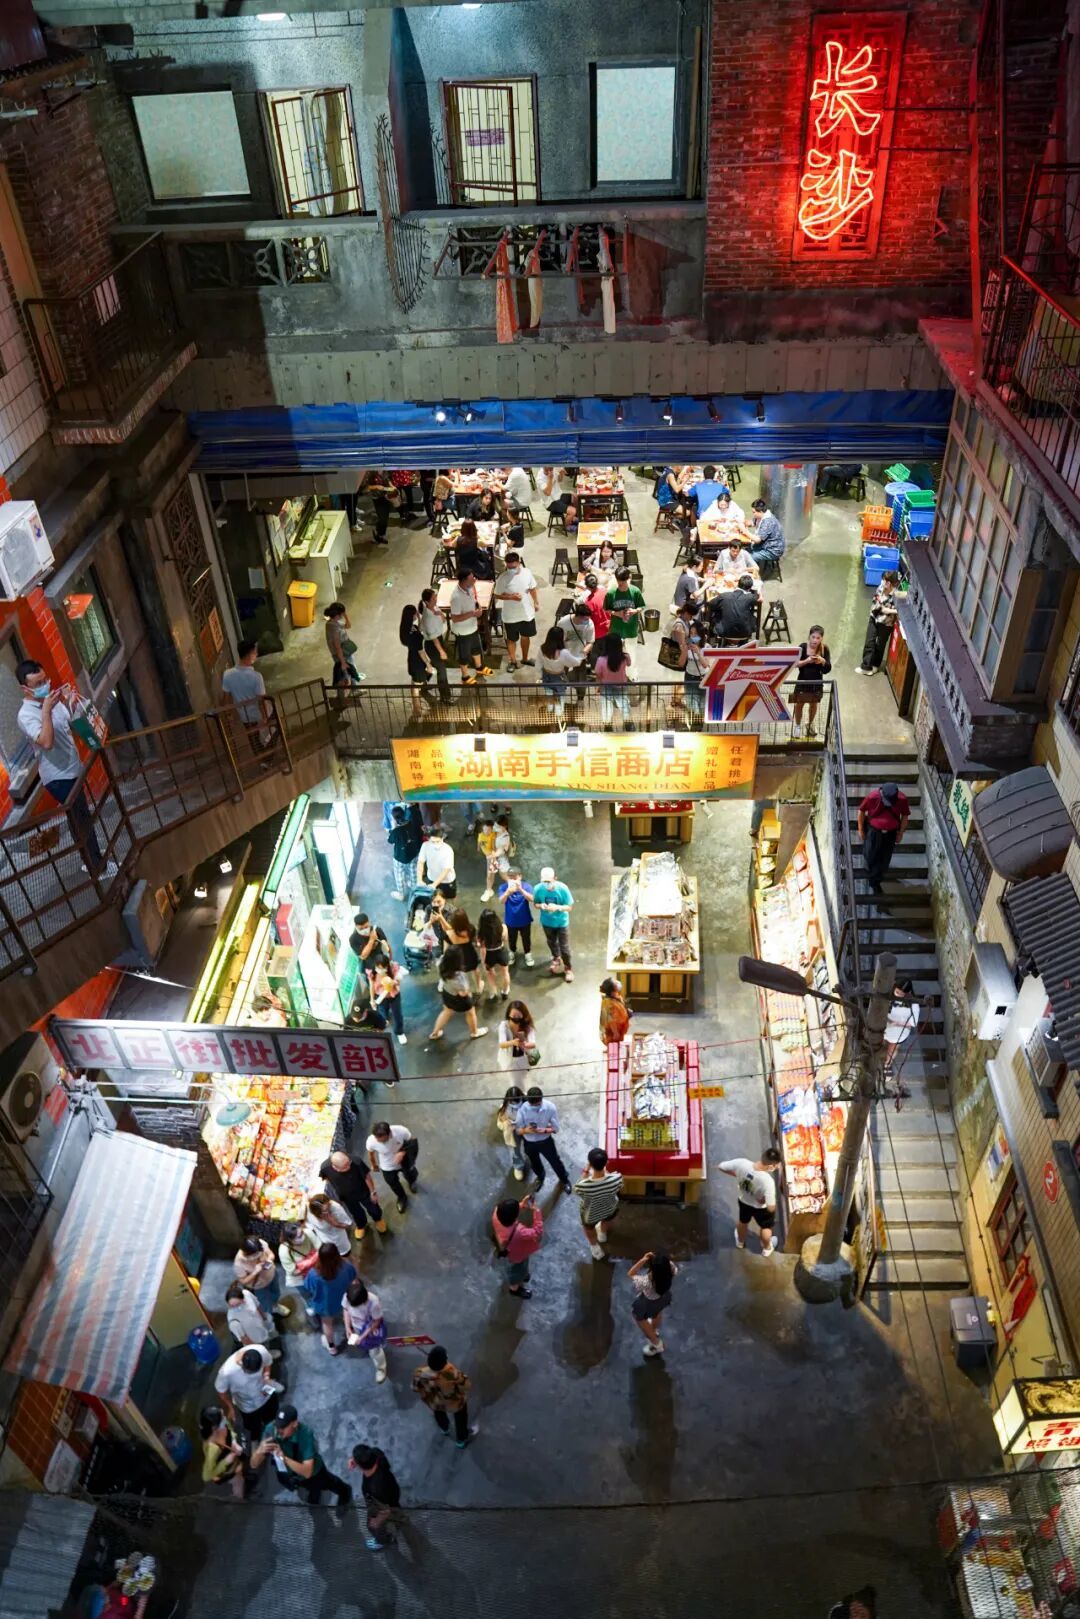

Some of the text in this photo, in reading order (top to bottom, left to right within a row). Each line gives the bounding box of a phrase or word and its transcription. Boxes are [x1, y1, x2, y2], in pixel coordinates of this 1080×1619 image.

[799, 41, 881, 240] 长沙
[728, 670, 776, 680] Budweiser
[456, 746, 695, 778] 湖南手信商店
[596, 782, 648, 790] SHANG
[653, 782, 692, 790] DIAN
[71, 1033, 390, 1073] 北正街批发部
